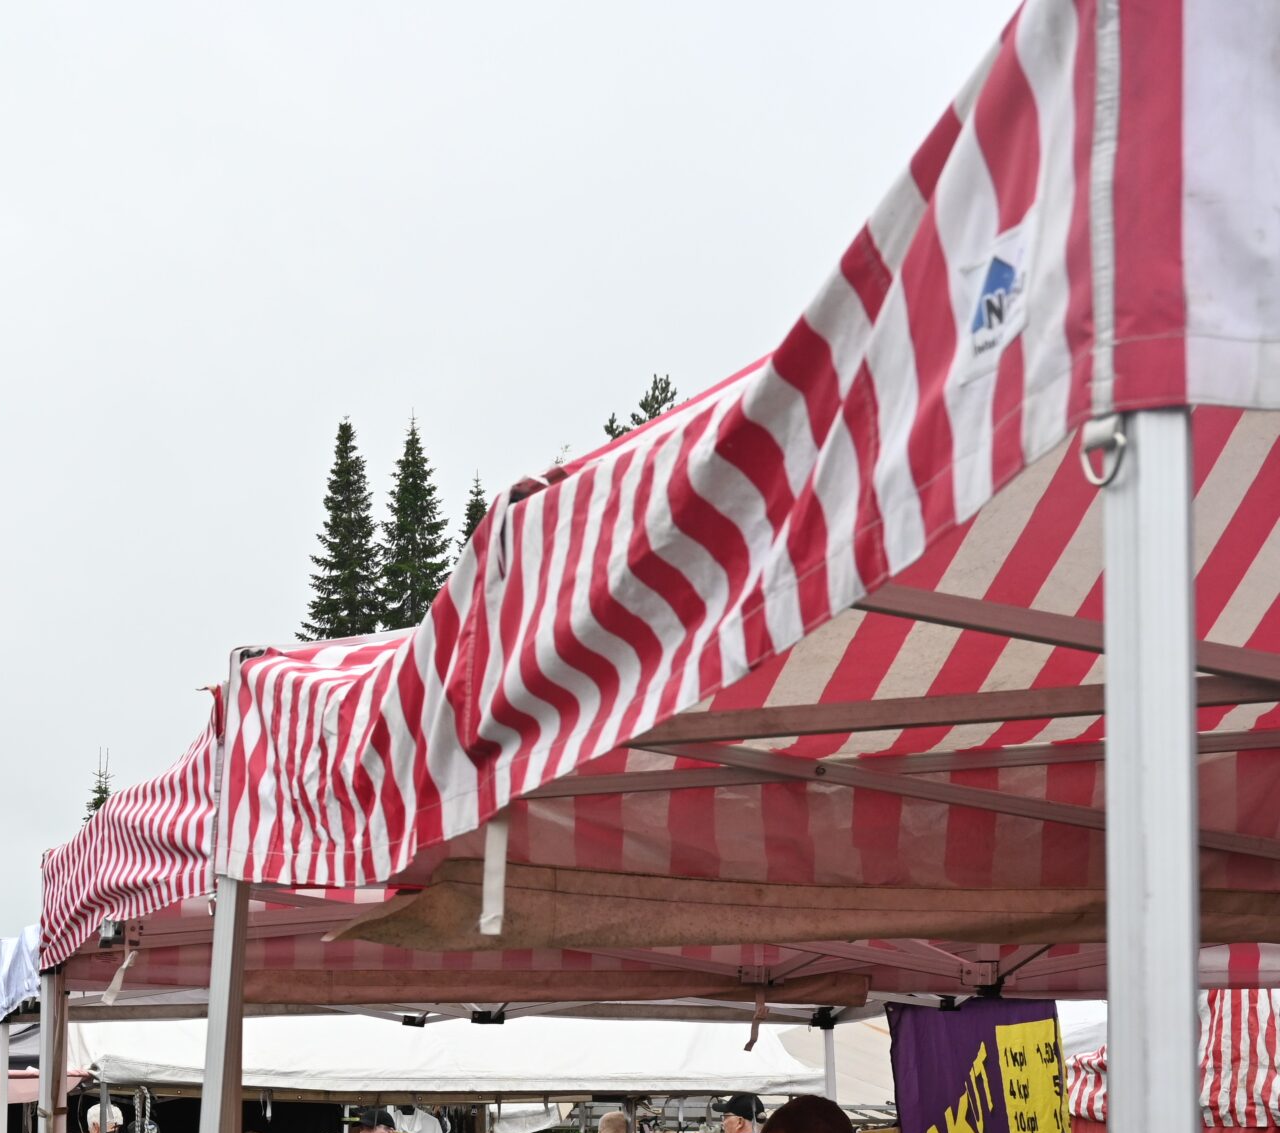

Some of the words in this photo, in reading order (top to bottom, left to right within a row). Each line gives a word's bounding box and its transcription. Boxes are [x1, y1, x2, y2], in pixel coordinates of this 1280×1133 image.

[1004, 1047, 1009, 1067] 1
[1012, 1048, 1027, 1072] kpl
[1009, 1079, 1016, 1099] 4
[1014, 1111, 1026, 1132] 10
